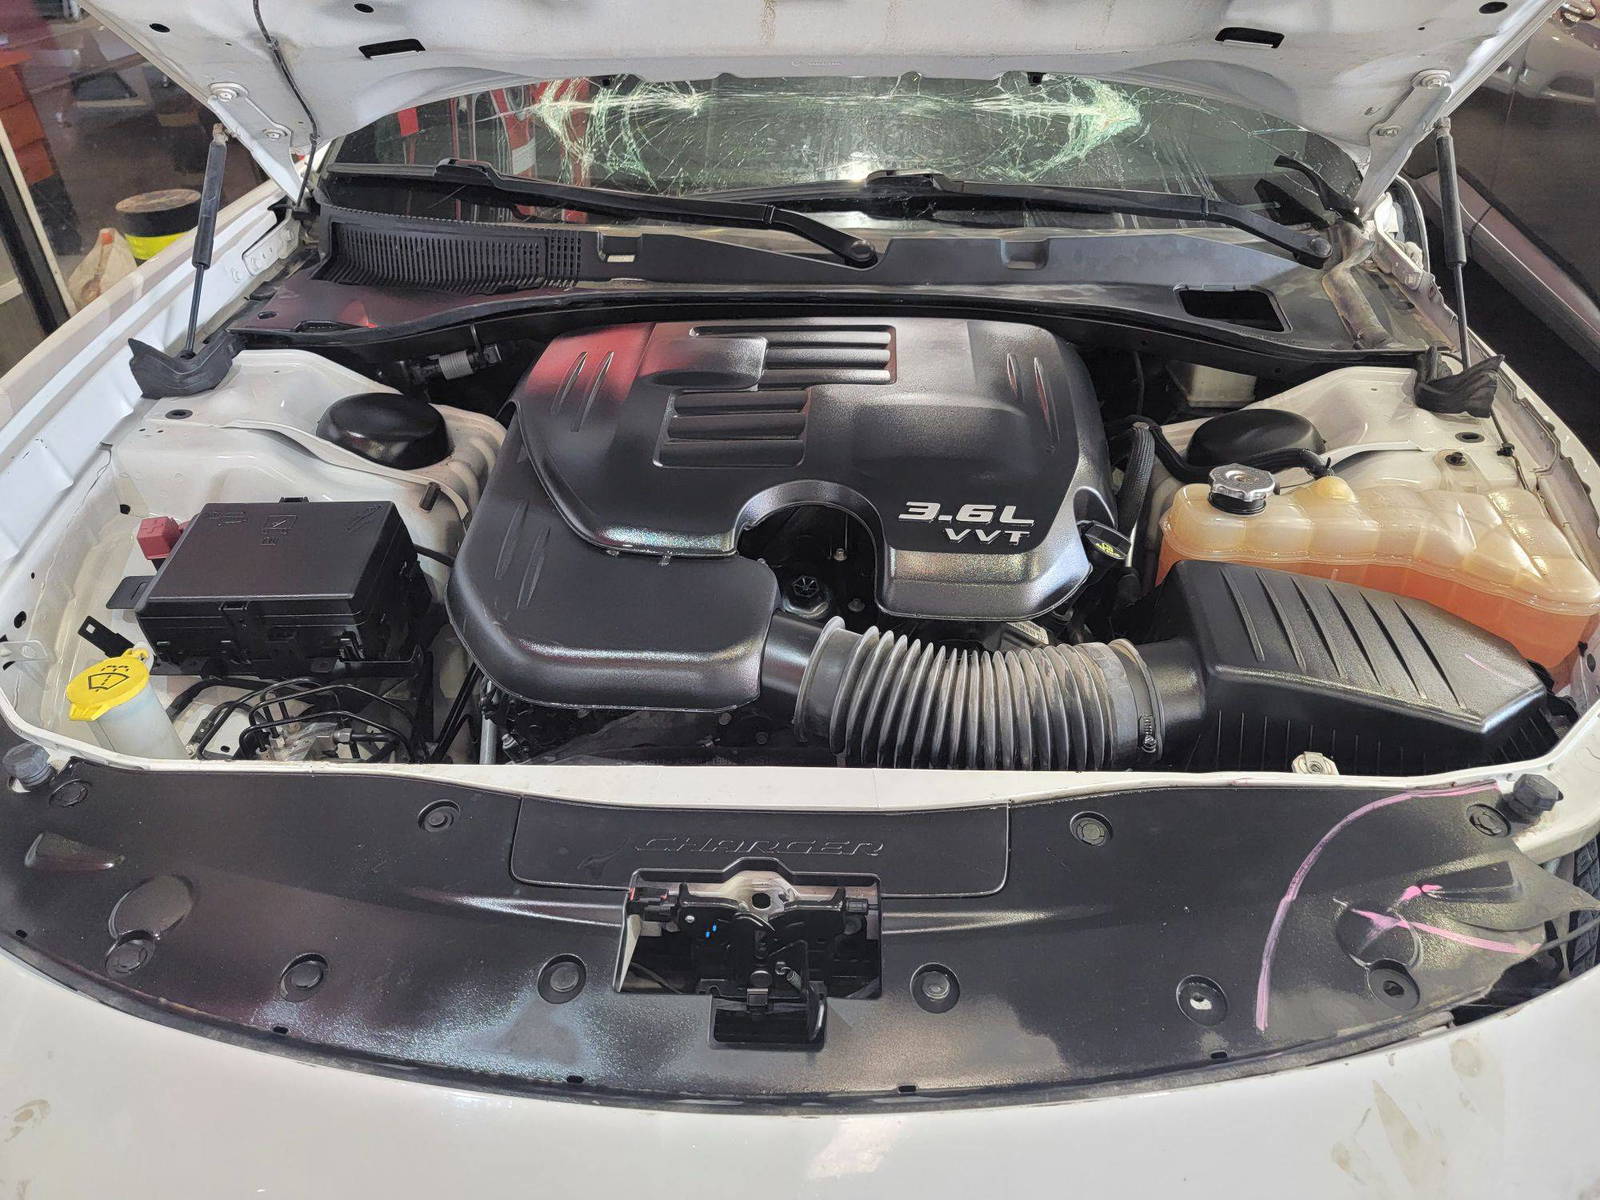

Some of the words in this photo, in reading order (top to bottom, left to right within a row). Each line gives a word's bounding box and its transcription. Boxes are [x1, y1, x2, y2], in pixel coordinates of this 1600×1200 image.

[898, 501, 1035, 526] 3.6L
[944, 528, 1030, 545] VVT
[634, 836, 884, 857] CHARGER
